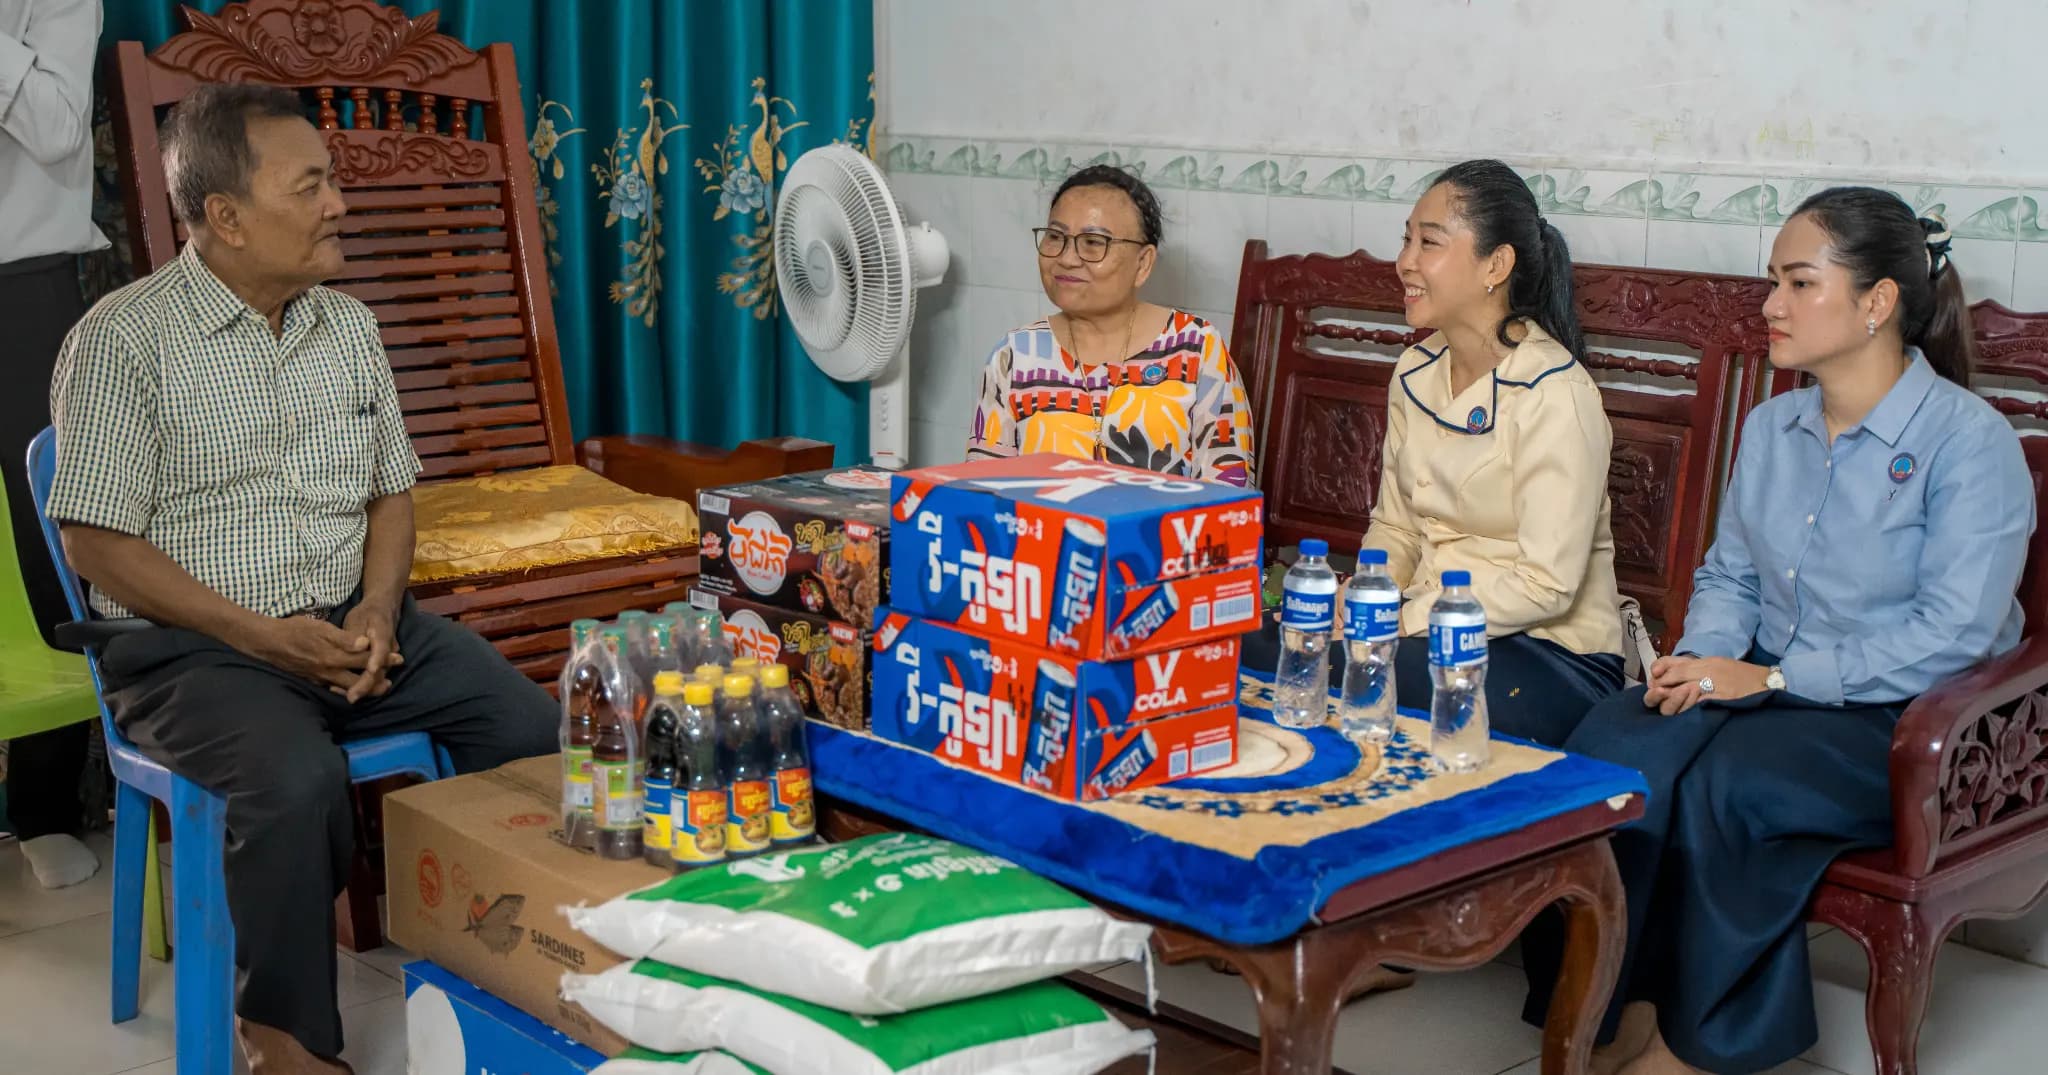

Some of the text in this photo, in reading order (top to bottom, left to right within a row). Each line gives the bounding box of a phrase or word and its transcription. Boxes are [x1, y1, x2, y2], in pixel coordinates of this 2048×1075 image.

[847, 523, 870, 538] NEW
[1171, 513, 1208, 555] V
[832, 626, 854, 641] NEW
[1146, 649, 1182, 690] V
[1134, 687, 1188, 712] COLA
[530, 928, 586, 966] SARDINES
